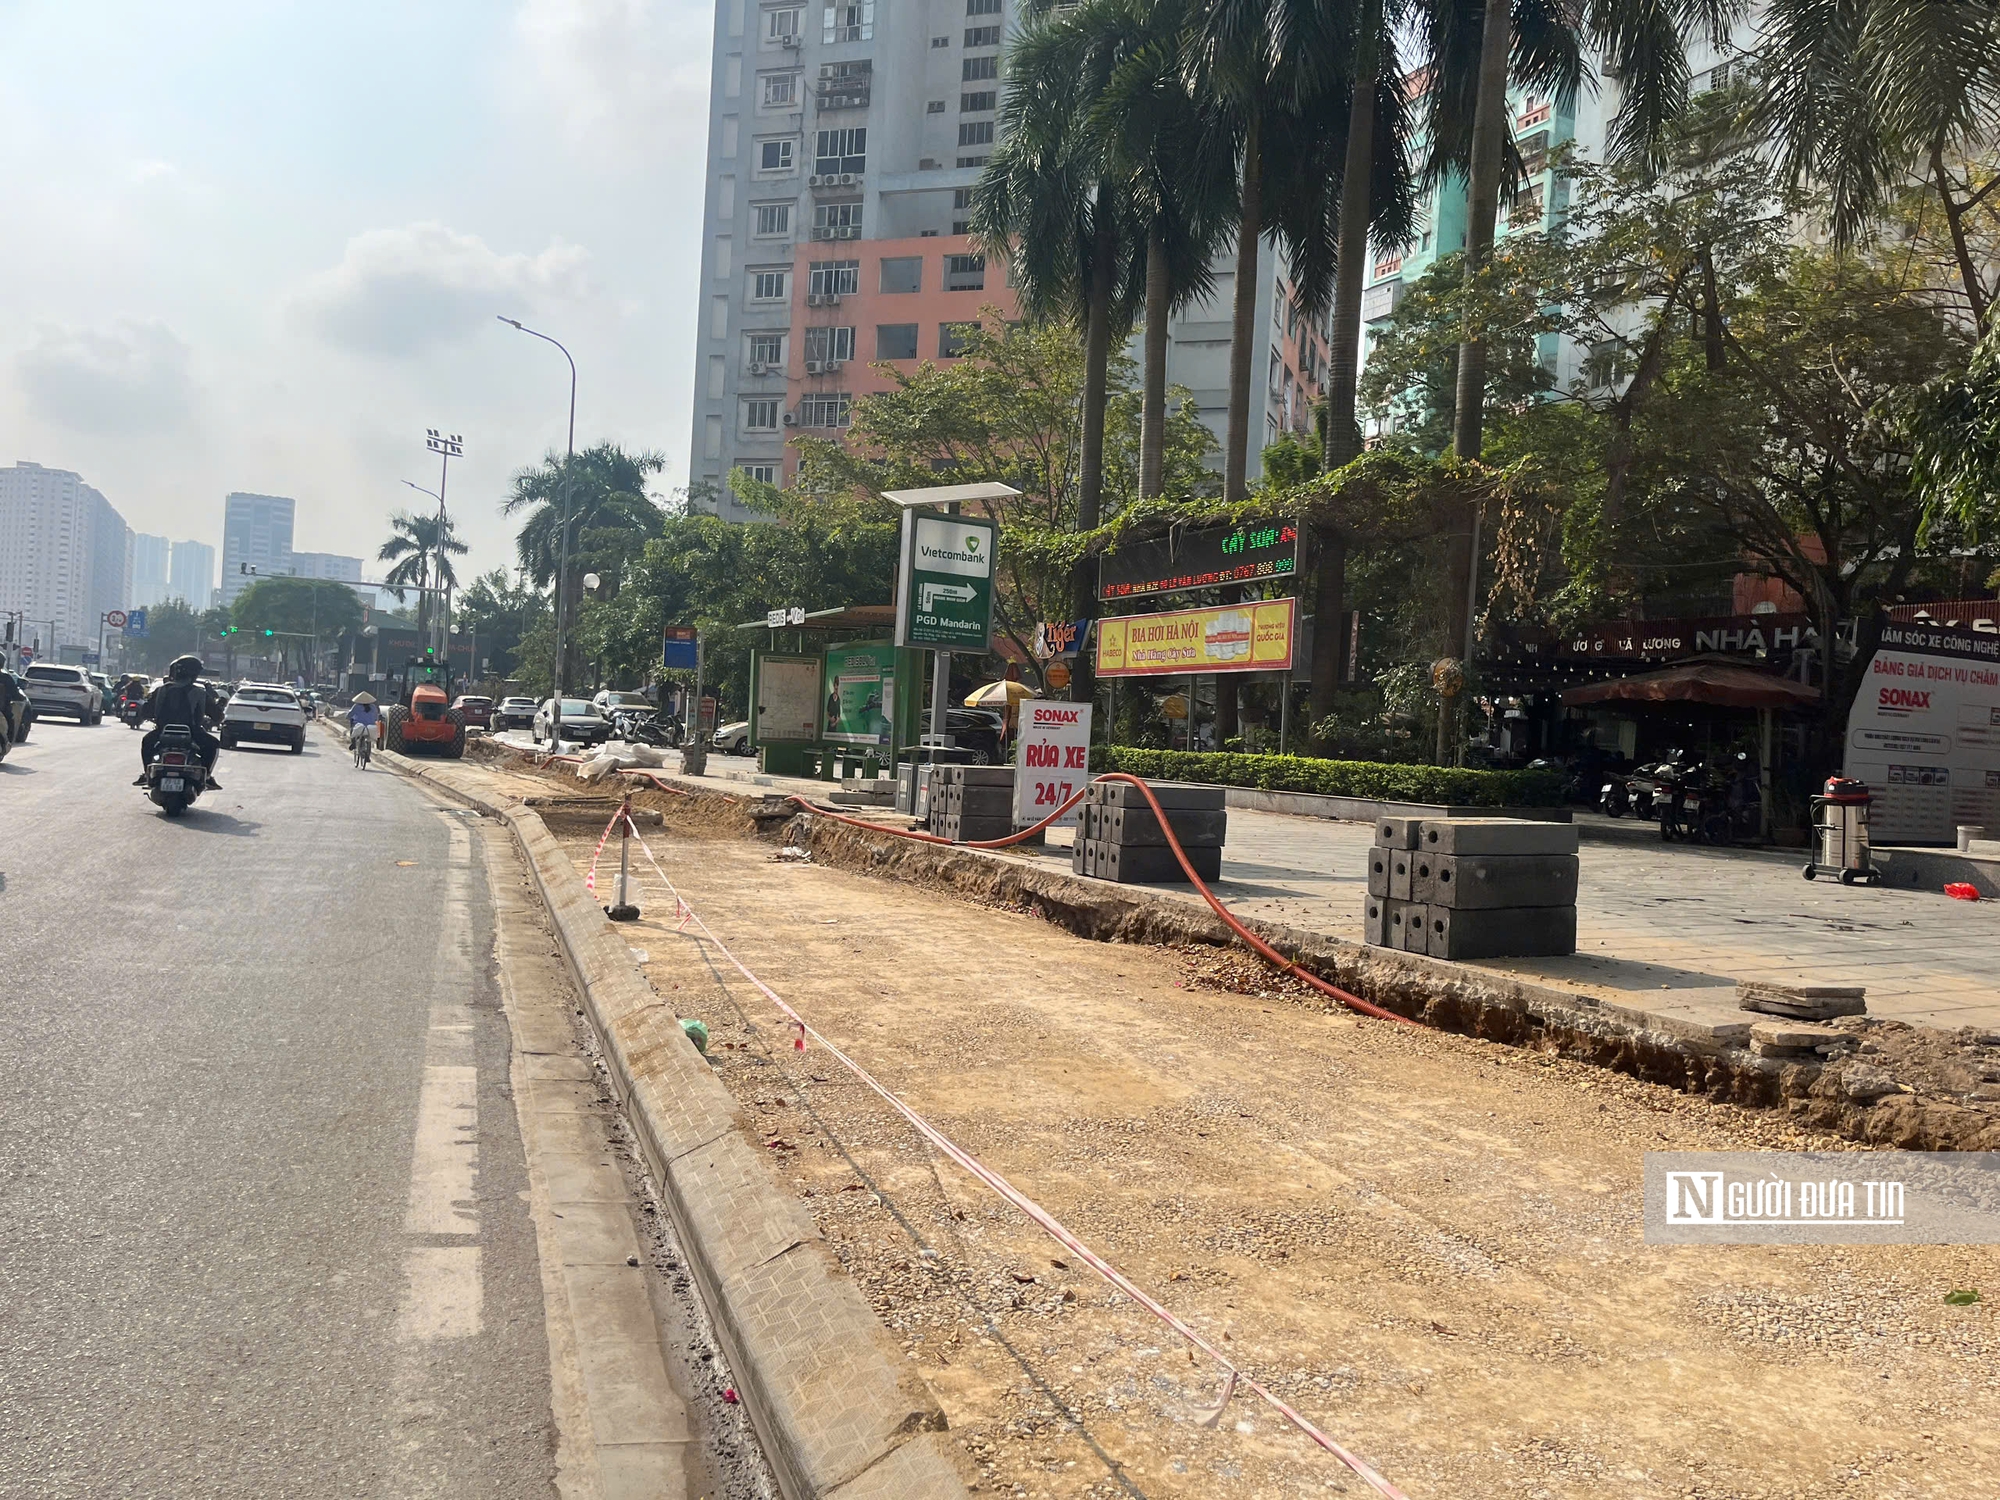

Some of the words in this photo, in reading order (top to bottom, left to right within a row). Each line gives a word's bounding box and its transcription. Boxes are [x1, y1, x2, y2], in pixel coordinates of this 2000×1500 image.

[921, 545, 985, 564] Vietcombank
[916, 615, 937, 625] PGD
[940, 617, 981, 630] Mandarin
[1132, 627, 1146, 643] BIA
[1148, 626, 1164, 641] HƠI
[1166, 621, 1179, 640] HÀ
[1182, 619, 1199, 643] NỘI
[1047, 621, 1076, 652] Tiger
[1274, 632, 1285, 641] GIA
[1695, 619, 1767, 651] NHÀ
[1904, 629, 1926, 647] SÓC
[1928, 634, 1942, 649] XE
[1943, 635, 1971, 654] CÔNG
[1132, 649, 1146, 661] Nhà
[1147, 648, 1166, 663] Hàng
[1167, 646, 1182, 662] Cây
[1873, 656, 1904, 676] BẢNG
[1907, 661, 1925, 679] GIÁ
[1927, 664, 1952, 683] DỊCH
[1954, 670, 1968, 687] VỤ
[1970, 669, 1998, 687] CHĂM
[1879, 687, 1931, 708] SONAX
[1034, 709, 1078, 723] SONAX
[1026, 738, 1059, 768] RỬA
[1063, 746, 1086, 769] XE
[1034, 781, 1073, 808] 24/7
